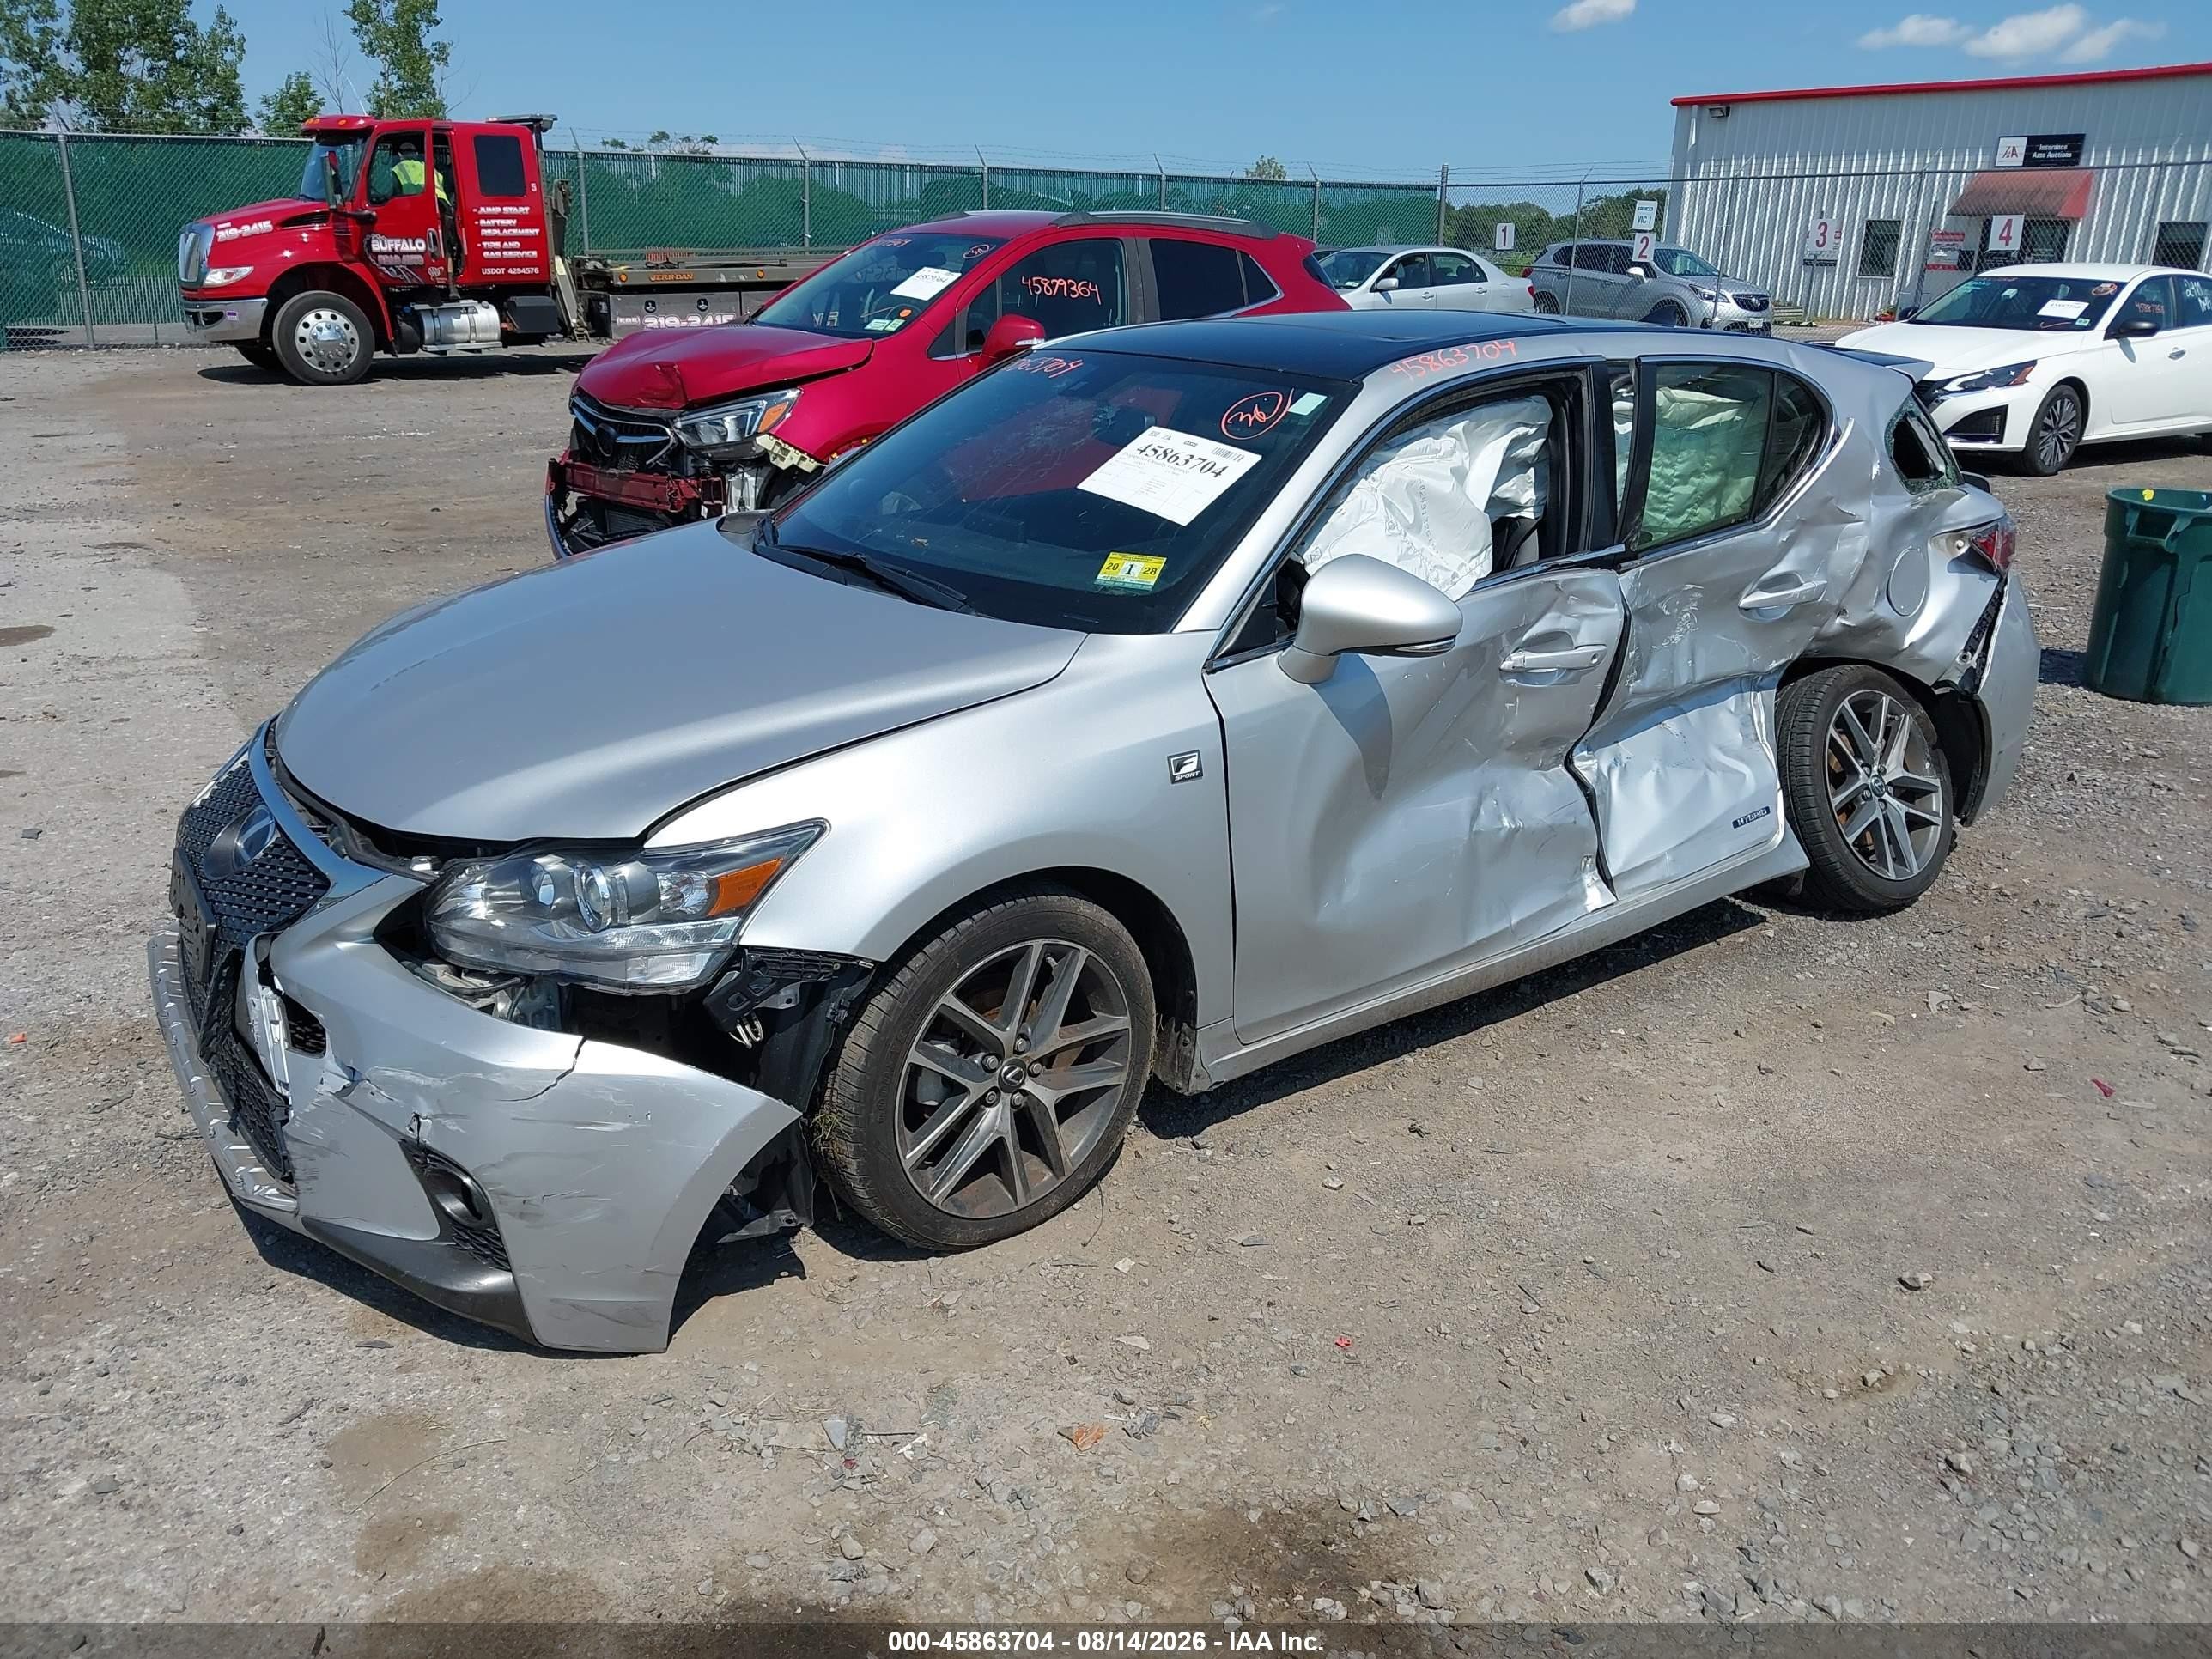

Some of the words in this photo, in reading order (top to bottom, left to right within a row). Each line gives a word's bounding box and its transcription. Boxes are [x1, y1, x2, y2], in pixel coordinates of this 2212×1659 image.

[531, 183, 537, 192] 5
[478, 206, 501, 215] JUMP
[480, 218, 517, 227] BATTERY
[1637, 216, 1648, 224] VIC
[1501, 225, 1508, 247] 1
[1815, 222, 1828, 248] 3
[1998, 218, 2014, 247] 4
[371, 238, 427, 252] BUFFALO
[1638, 235, 1650, 259] 2
[483, 250, 501, 258] GAS
[502, 250, 538, 258] SERVICE
[1021, 276, 1102, 305] 45879364
[1388, 339, 1517, 383] 45863704
[1136, 442, 1229, 478] 45863704
[1105, 562, 1120, 571] 20
[1125, 563, 1133, 575] 1
[1142, 567, 1158, 575] 28
[1174, 770, 1201, 781] SPORT
[1736, 808, 1768, 826] HYBRID
